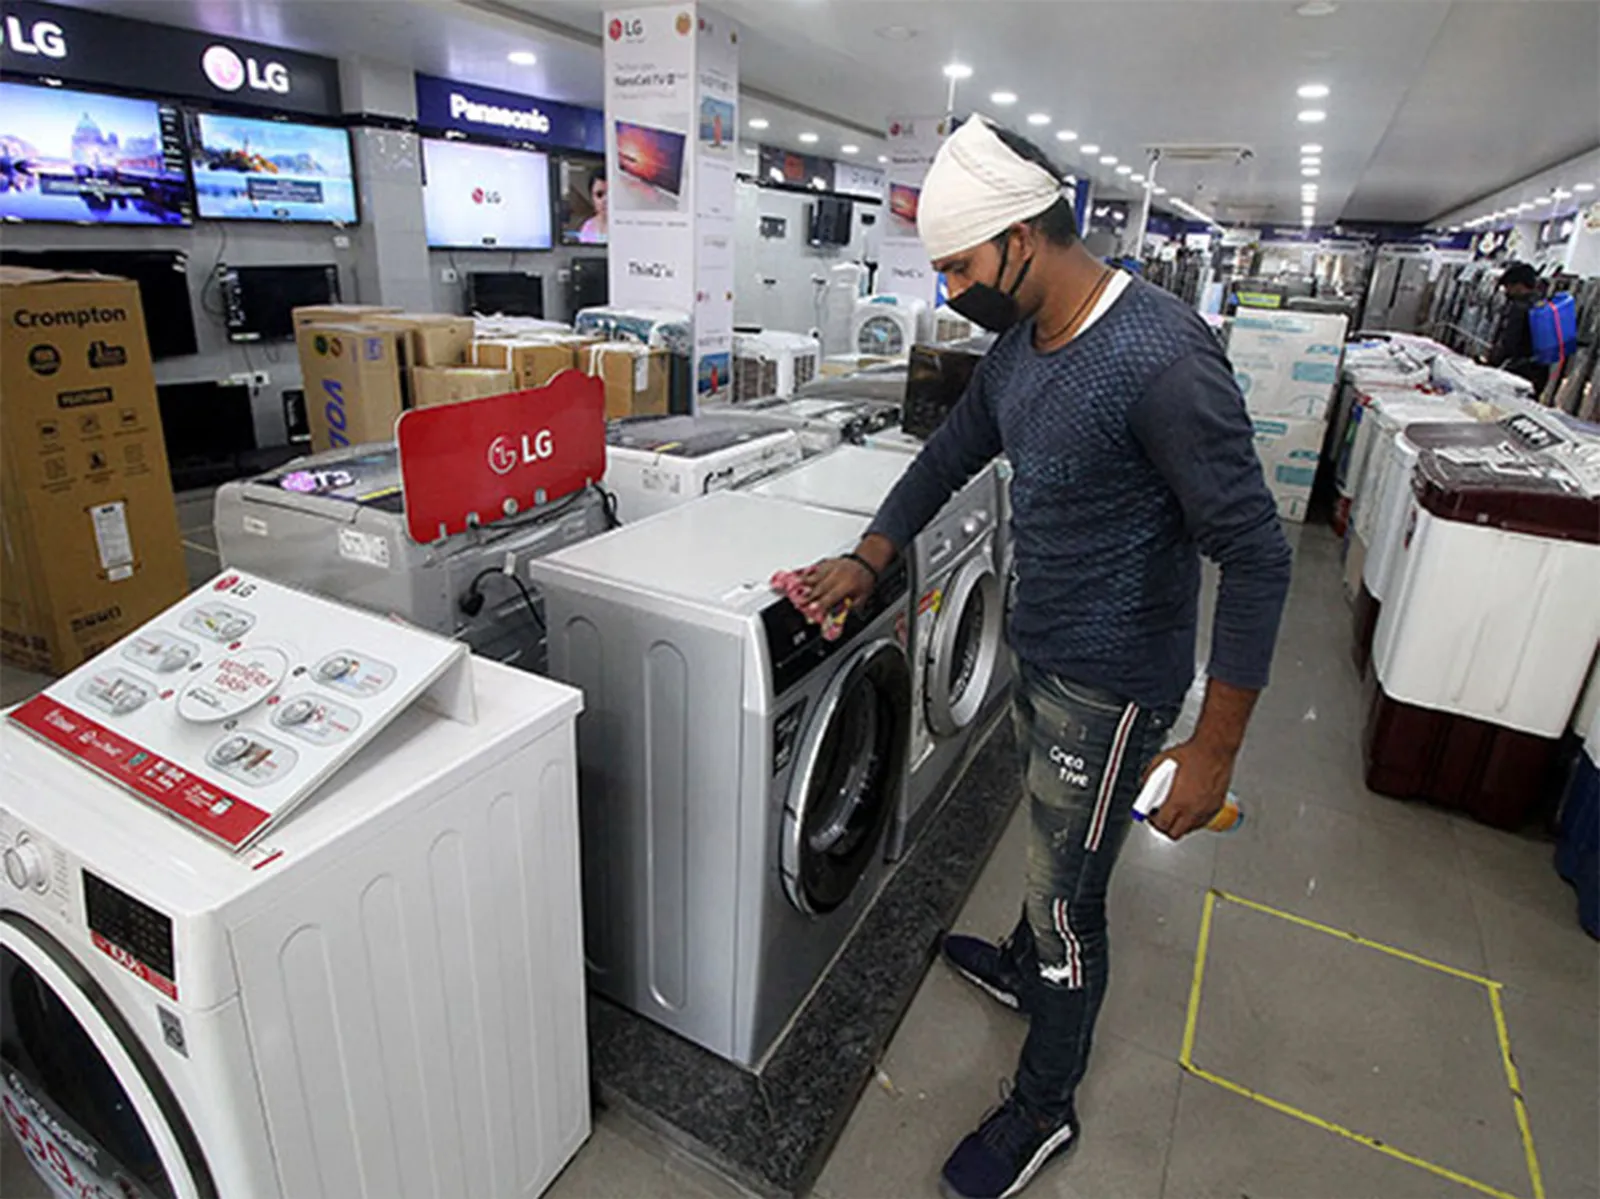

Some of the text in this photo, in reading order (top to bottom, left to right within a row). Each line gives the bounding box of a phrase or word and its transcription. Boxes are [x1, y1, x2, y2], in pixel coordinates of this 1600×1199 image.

[6, 15, 67, 58] LG
[624, 19, 643, 36] LG
[246, 58, 290, 93] LG
[450, 92, 550, 134] Panasonic
[485, 190, 502, 204] LG
[14, 306, 127, 329] Crompton
[521, 429, 553, 463] LG
[231, 581, 257, 598] LG
[1049, 745, 1085, 771] Crea
